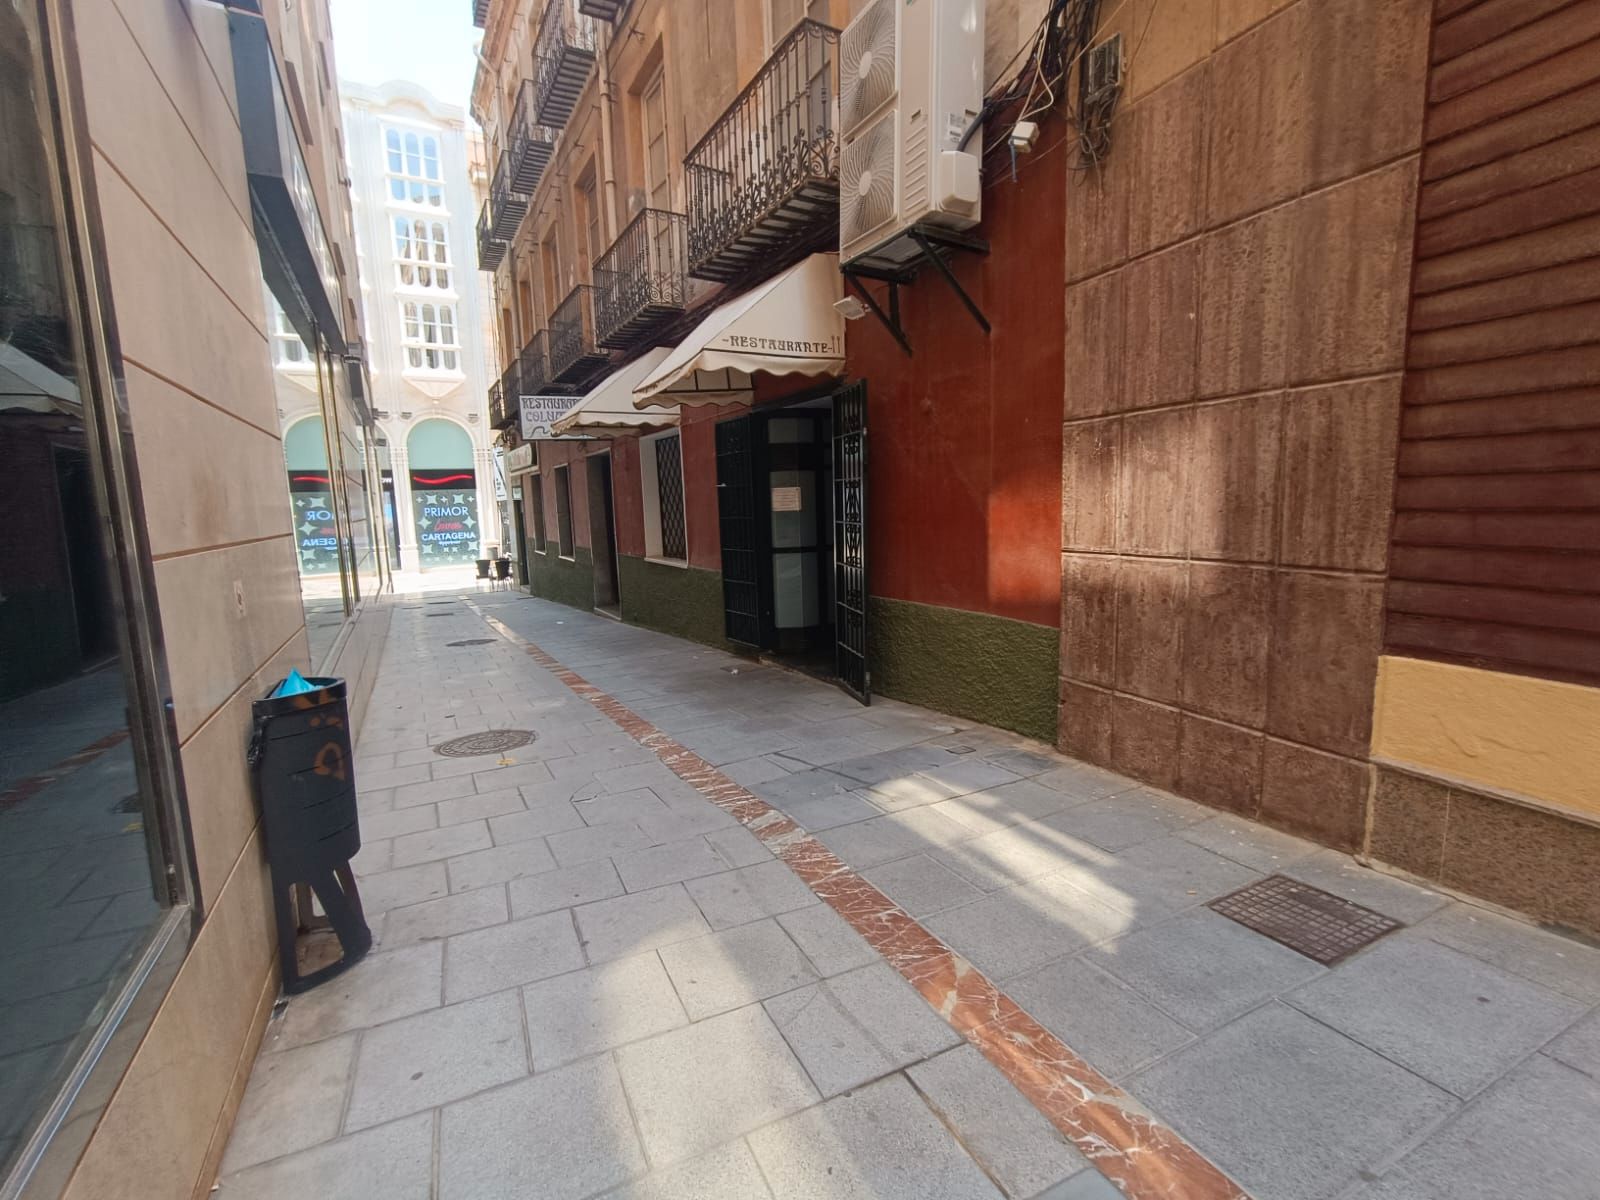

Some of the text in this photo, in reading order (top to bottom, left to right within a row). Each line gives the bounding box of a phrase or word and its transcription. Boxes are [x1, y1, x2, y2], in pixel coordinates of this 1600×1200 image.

[729, 335, 828, 353] RESTAURANTE
[424, 506, 469, 517] PRIMOR
[421, 531, 476, 541] CARTAGENA
